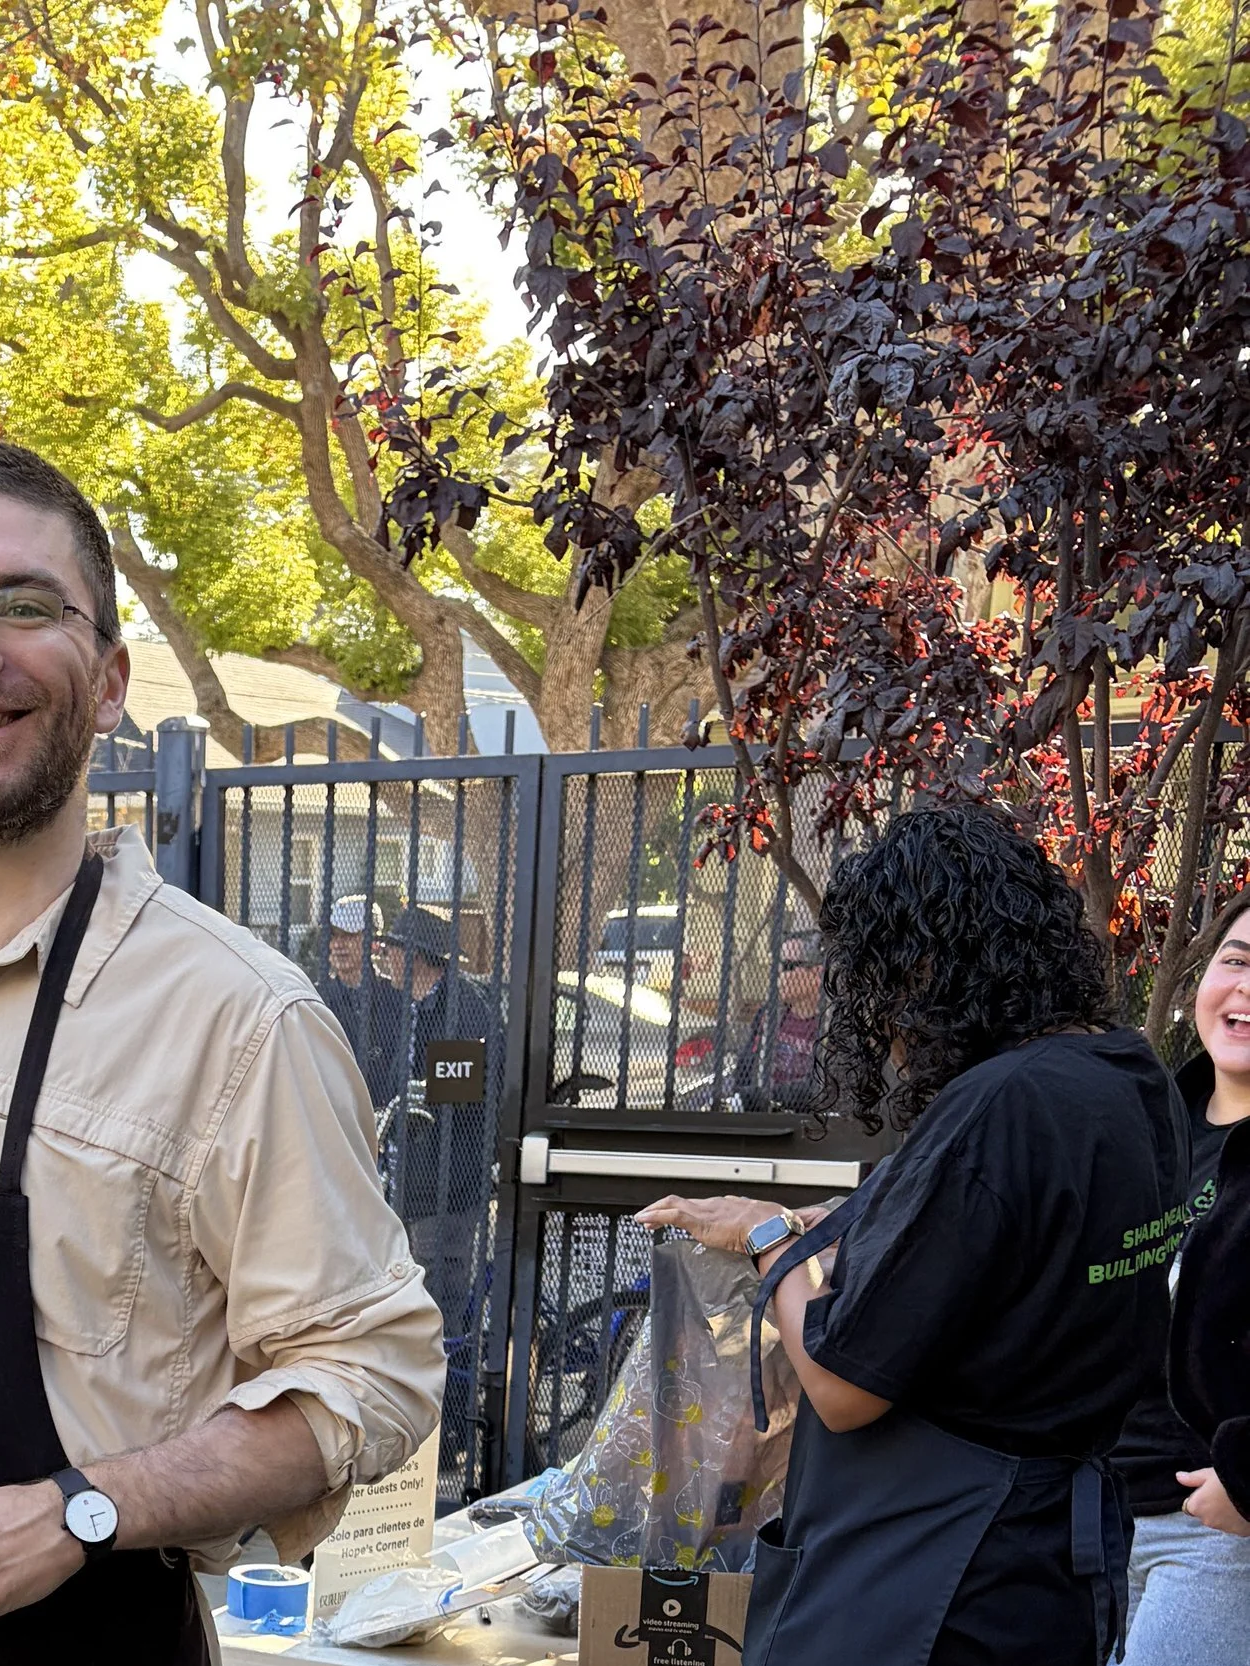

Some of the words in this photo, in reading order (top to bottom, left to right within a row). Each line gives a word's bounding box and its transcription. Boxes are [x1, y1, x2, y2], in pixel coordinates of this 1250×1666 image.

[435, 1061, 474, 1078] EXIT
[350, 1486, 365, 1499] ner
[367, 1482, 398, 1496] Guests
[400, 1477, 424, 1491] Only!
[353, 1526, 374, 1541] para
[376, 1520, 412, 1535] clientes
[413, 1516, 425, 1528] de
[341, 1543, 373, 1559] Hope's
[375, 1537, 410, 1553] Corner!
[642, 1618, 662, 1627] video
[663, 1619, 700, 1631] streaming
[653, 1656, 670, 1665] free
